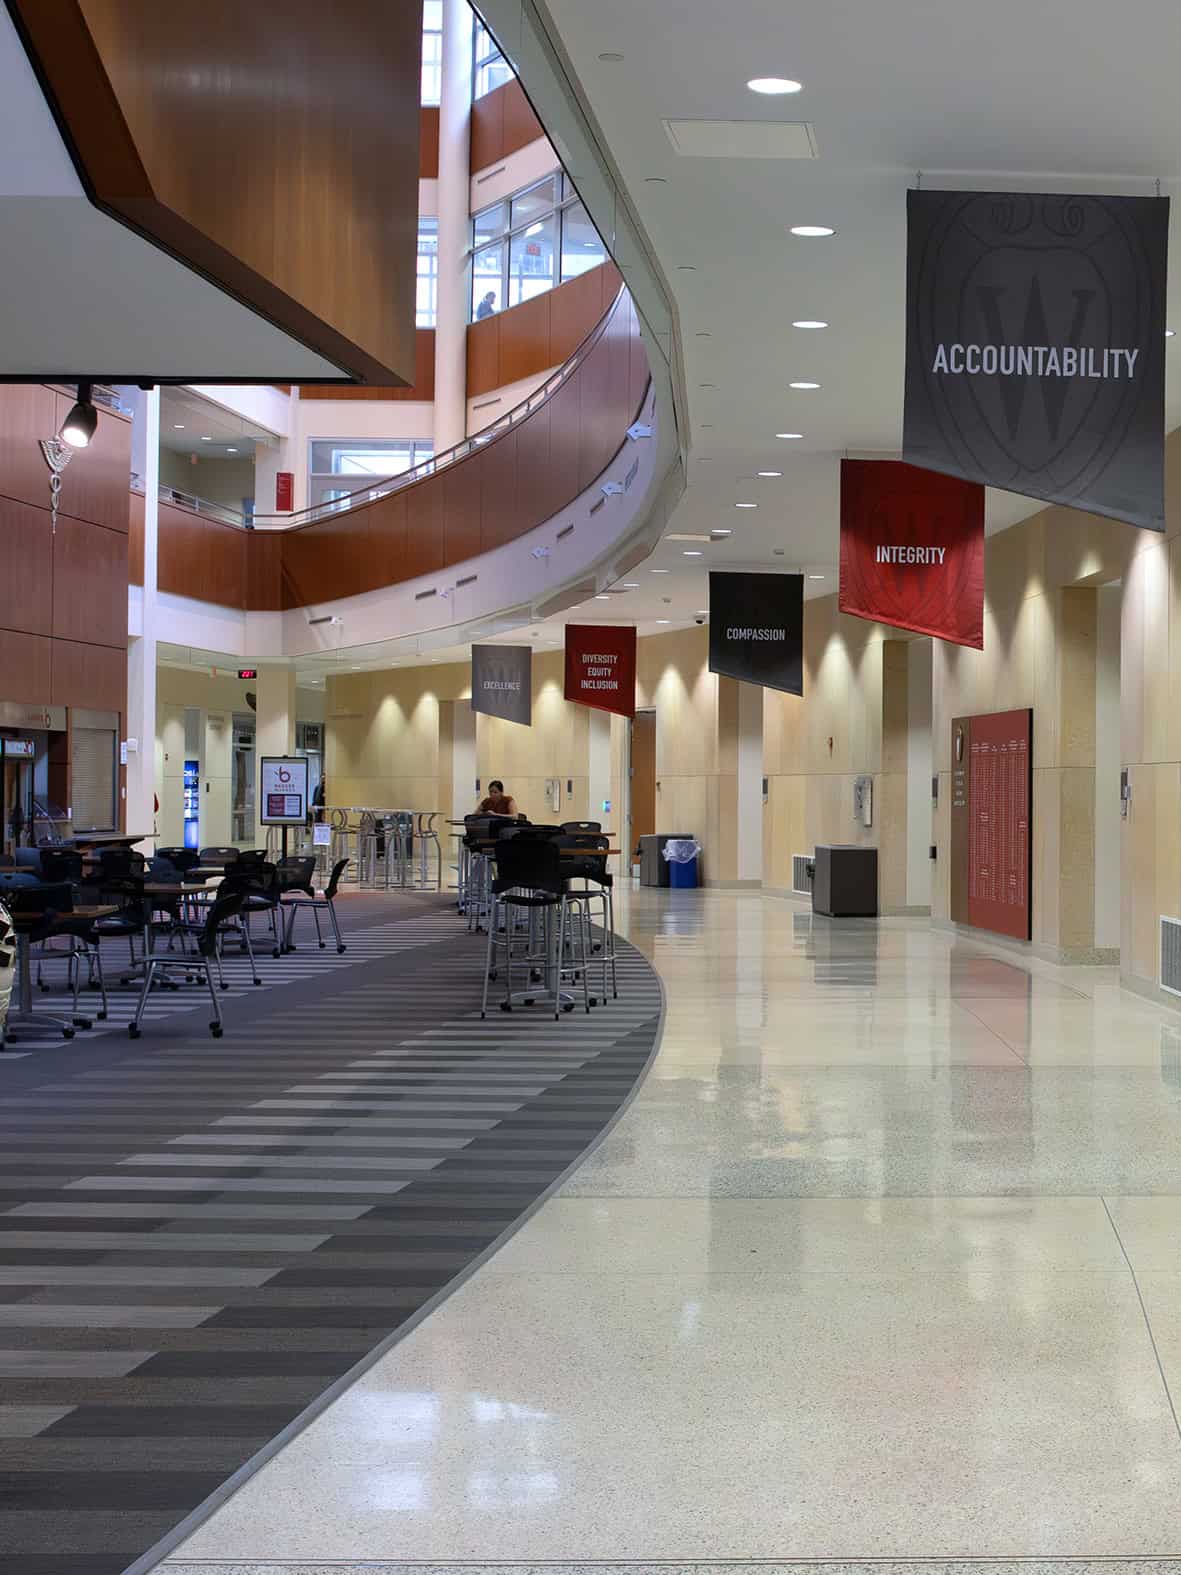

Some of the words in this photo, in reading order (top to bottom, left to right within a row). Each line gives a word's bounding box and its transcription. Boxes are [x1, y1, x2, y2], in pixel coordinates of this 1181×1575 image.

[932, 343, 1139, 379] ACCOUNTABILITY
[876, 545, 946, 565] INTEGRITY
[726, 627, 786, 641] COMPASSION
[582, 654, 618, 664] DIVERSITY
[587, 667, 612, 677] EQUITY
[483, 680, 521, 691] EXCELLENCE
[581, 679, 618, 690] INCLUSION
